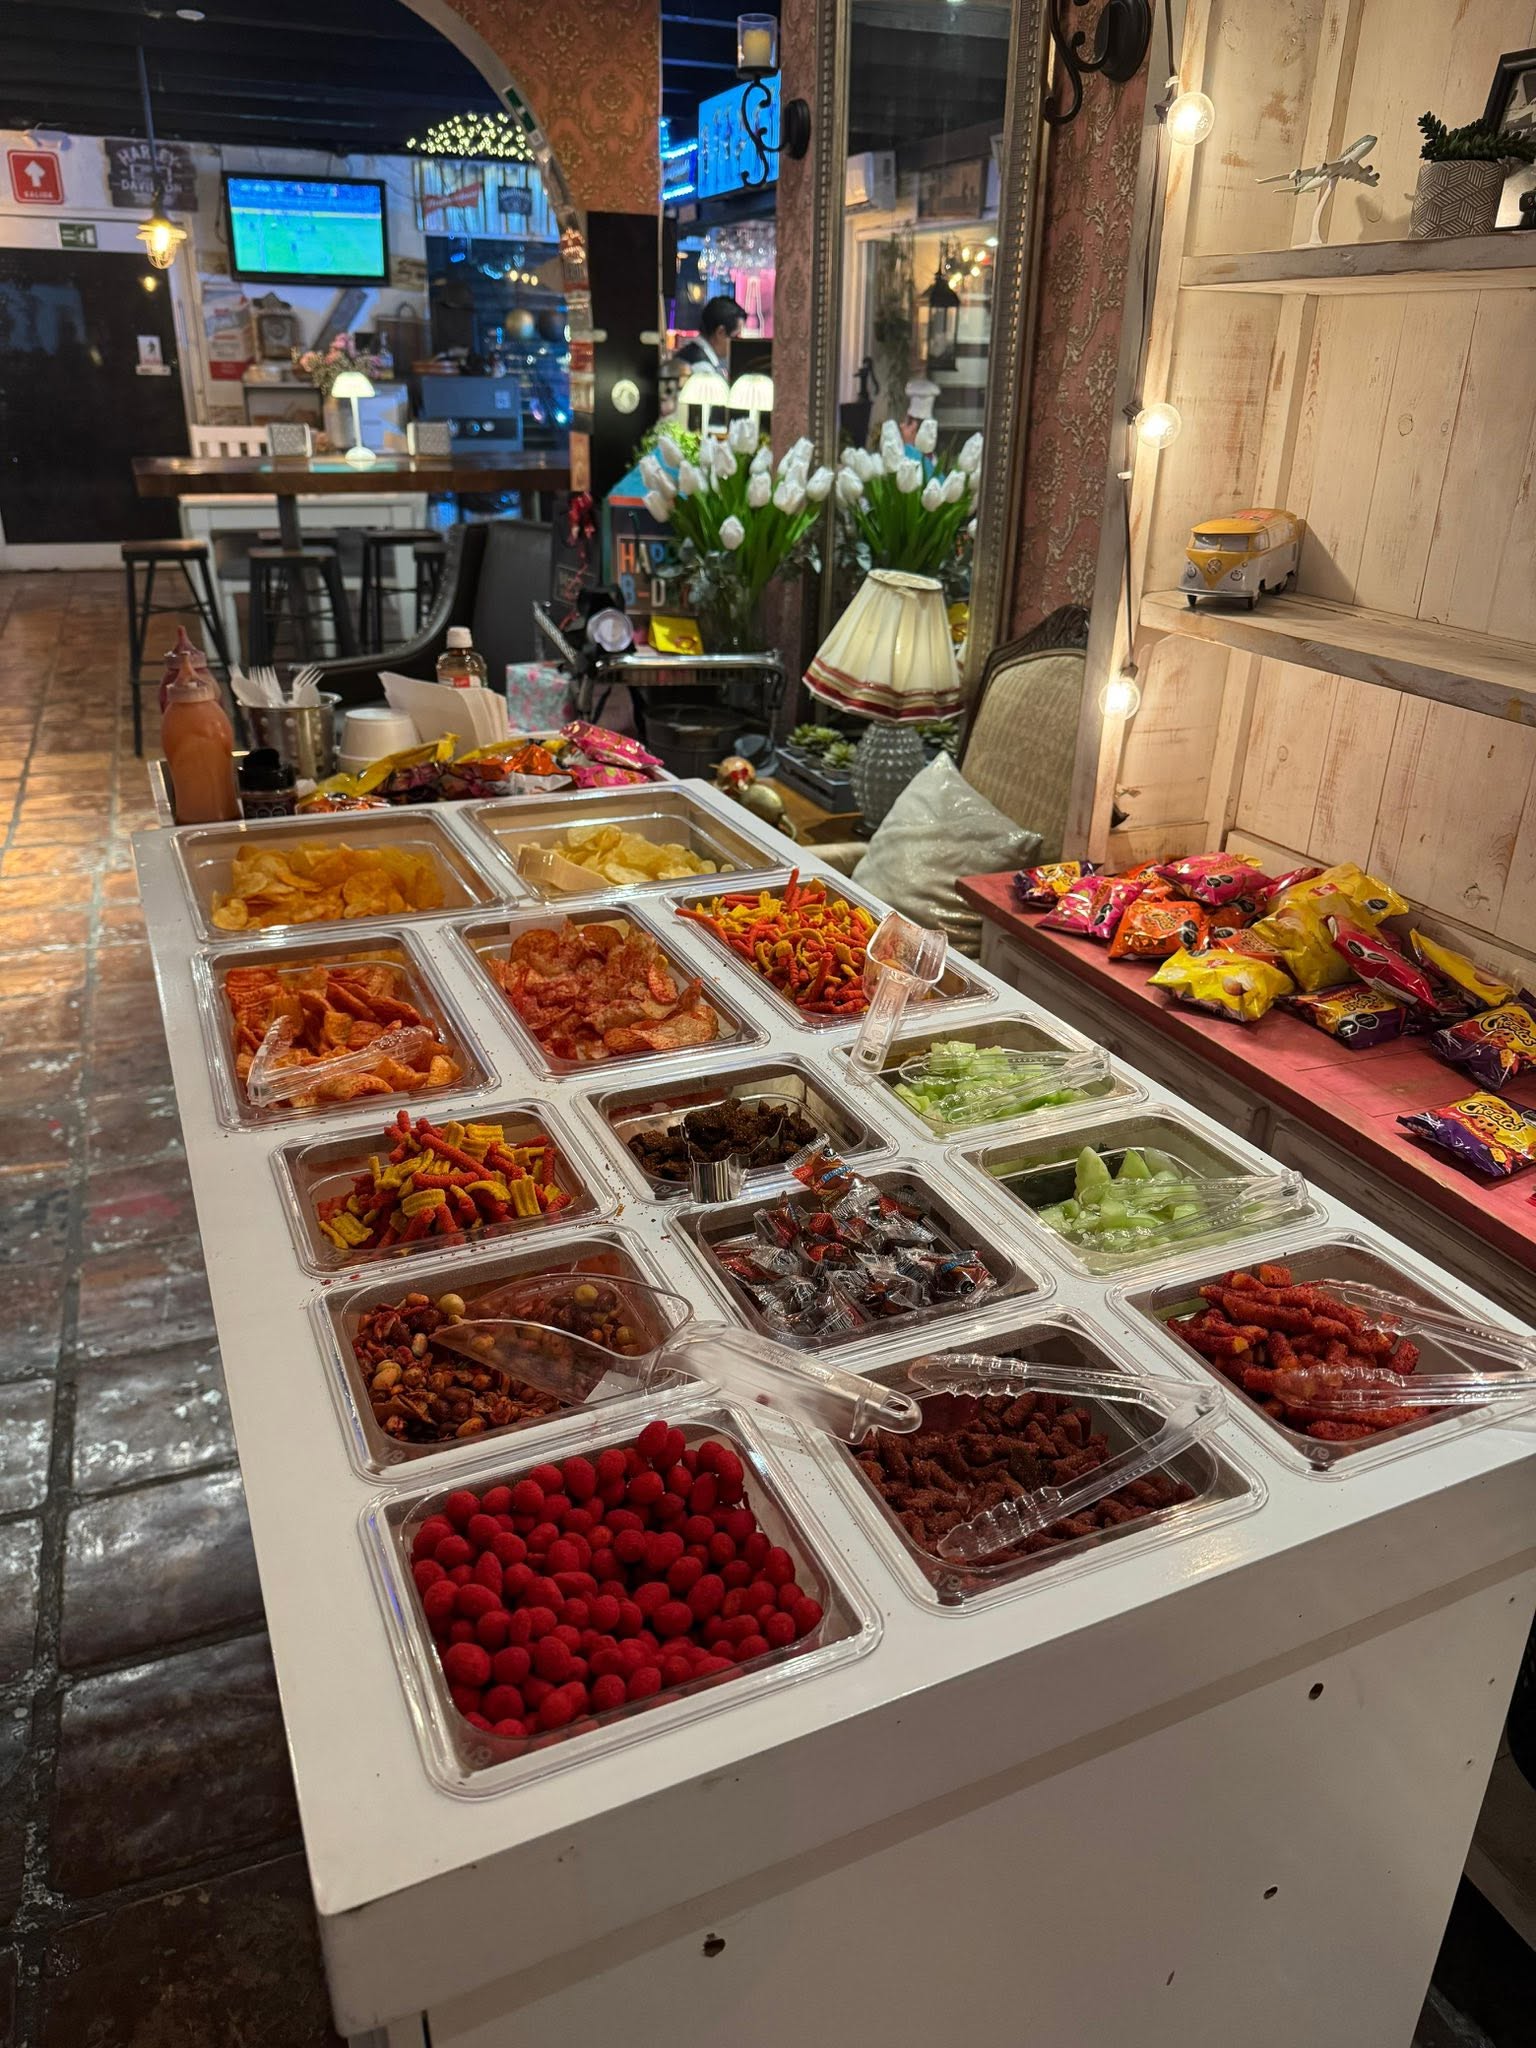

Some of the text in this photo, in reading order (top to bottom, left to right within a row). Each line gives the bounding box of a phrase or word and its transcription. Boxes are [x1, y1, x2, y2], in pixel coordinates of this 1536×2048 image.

[1480, 1014, 1536, 1046] Cheetos
[1459, 1101, 1526, 1131] Cheetos
[652, 1183, 672, 1193] 1/9
[1301, 1443, 1330, 1460] 1/9
[931, 1569, 962, 1591] 1/9
